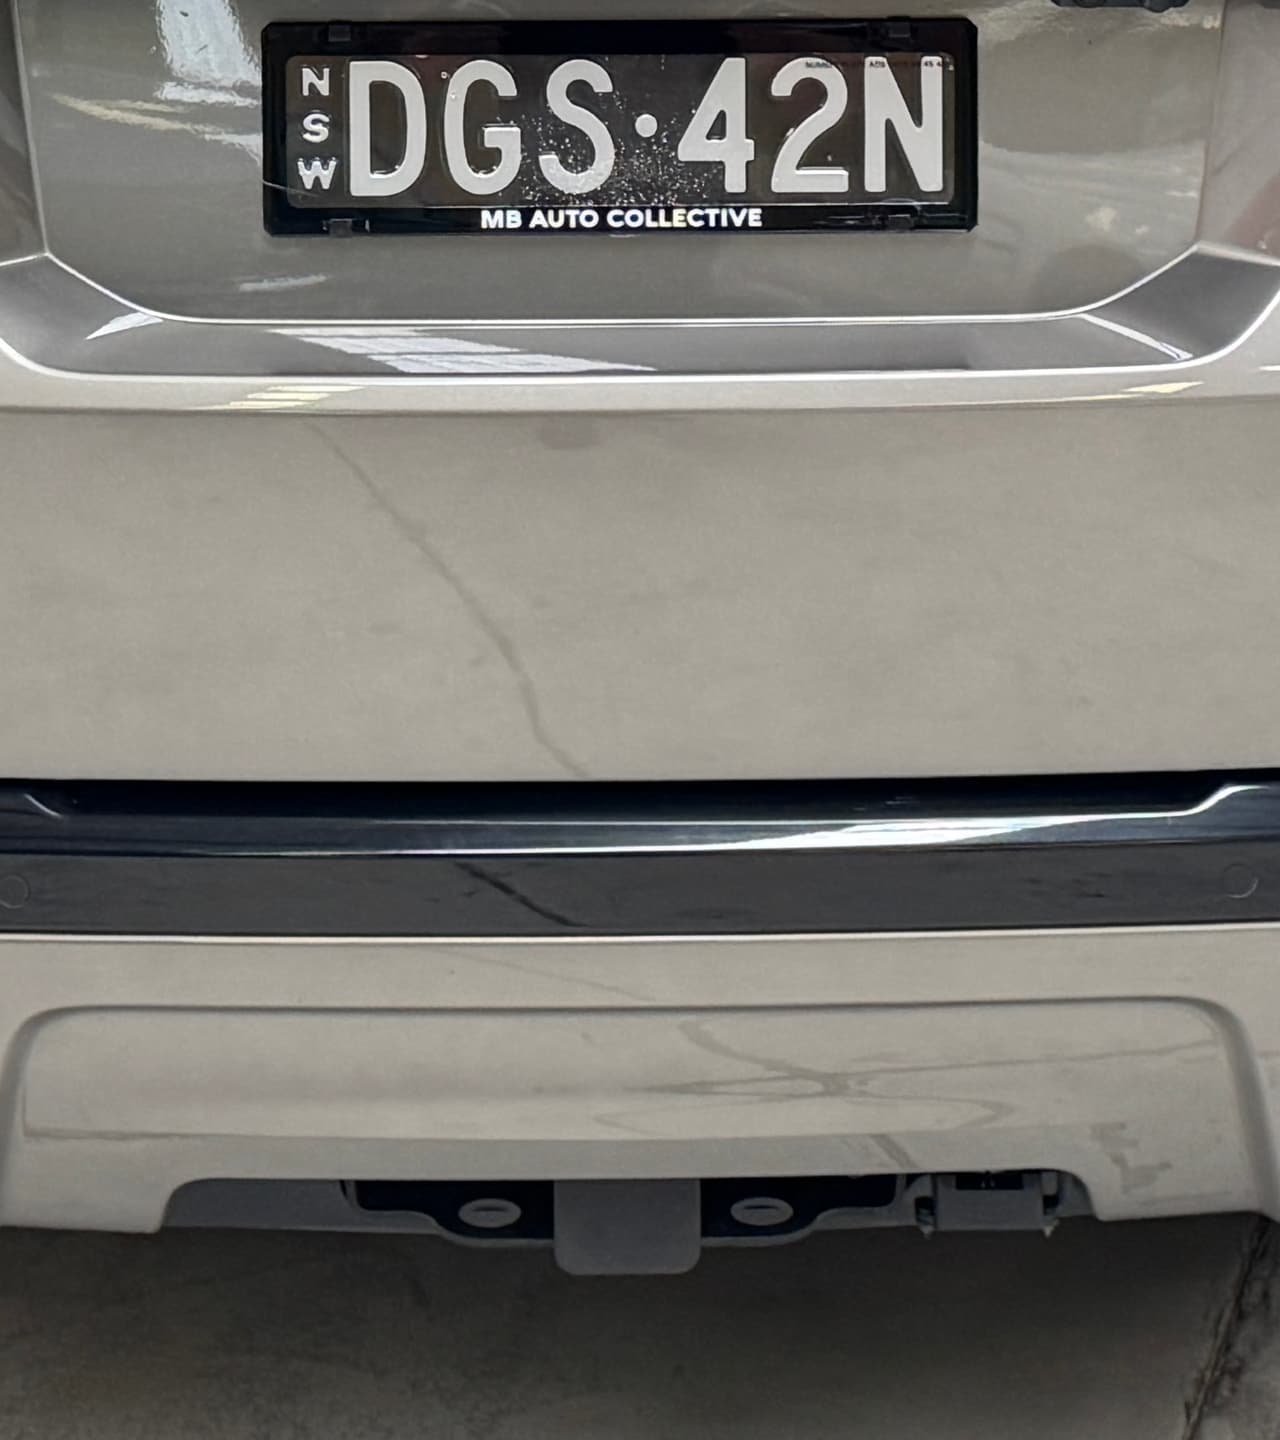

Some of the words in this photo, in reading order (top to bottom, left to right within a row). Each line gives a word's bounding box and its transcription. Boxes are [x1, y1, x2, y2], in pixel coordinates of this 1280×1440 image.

[480, 209, 521, 229] MB
[528, 209, 600, 229] AUTO
[606, 208, 763, 228] COLLECTIVE
